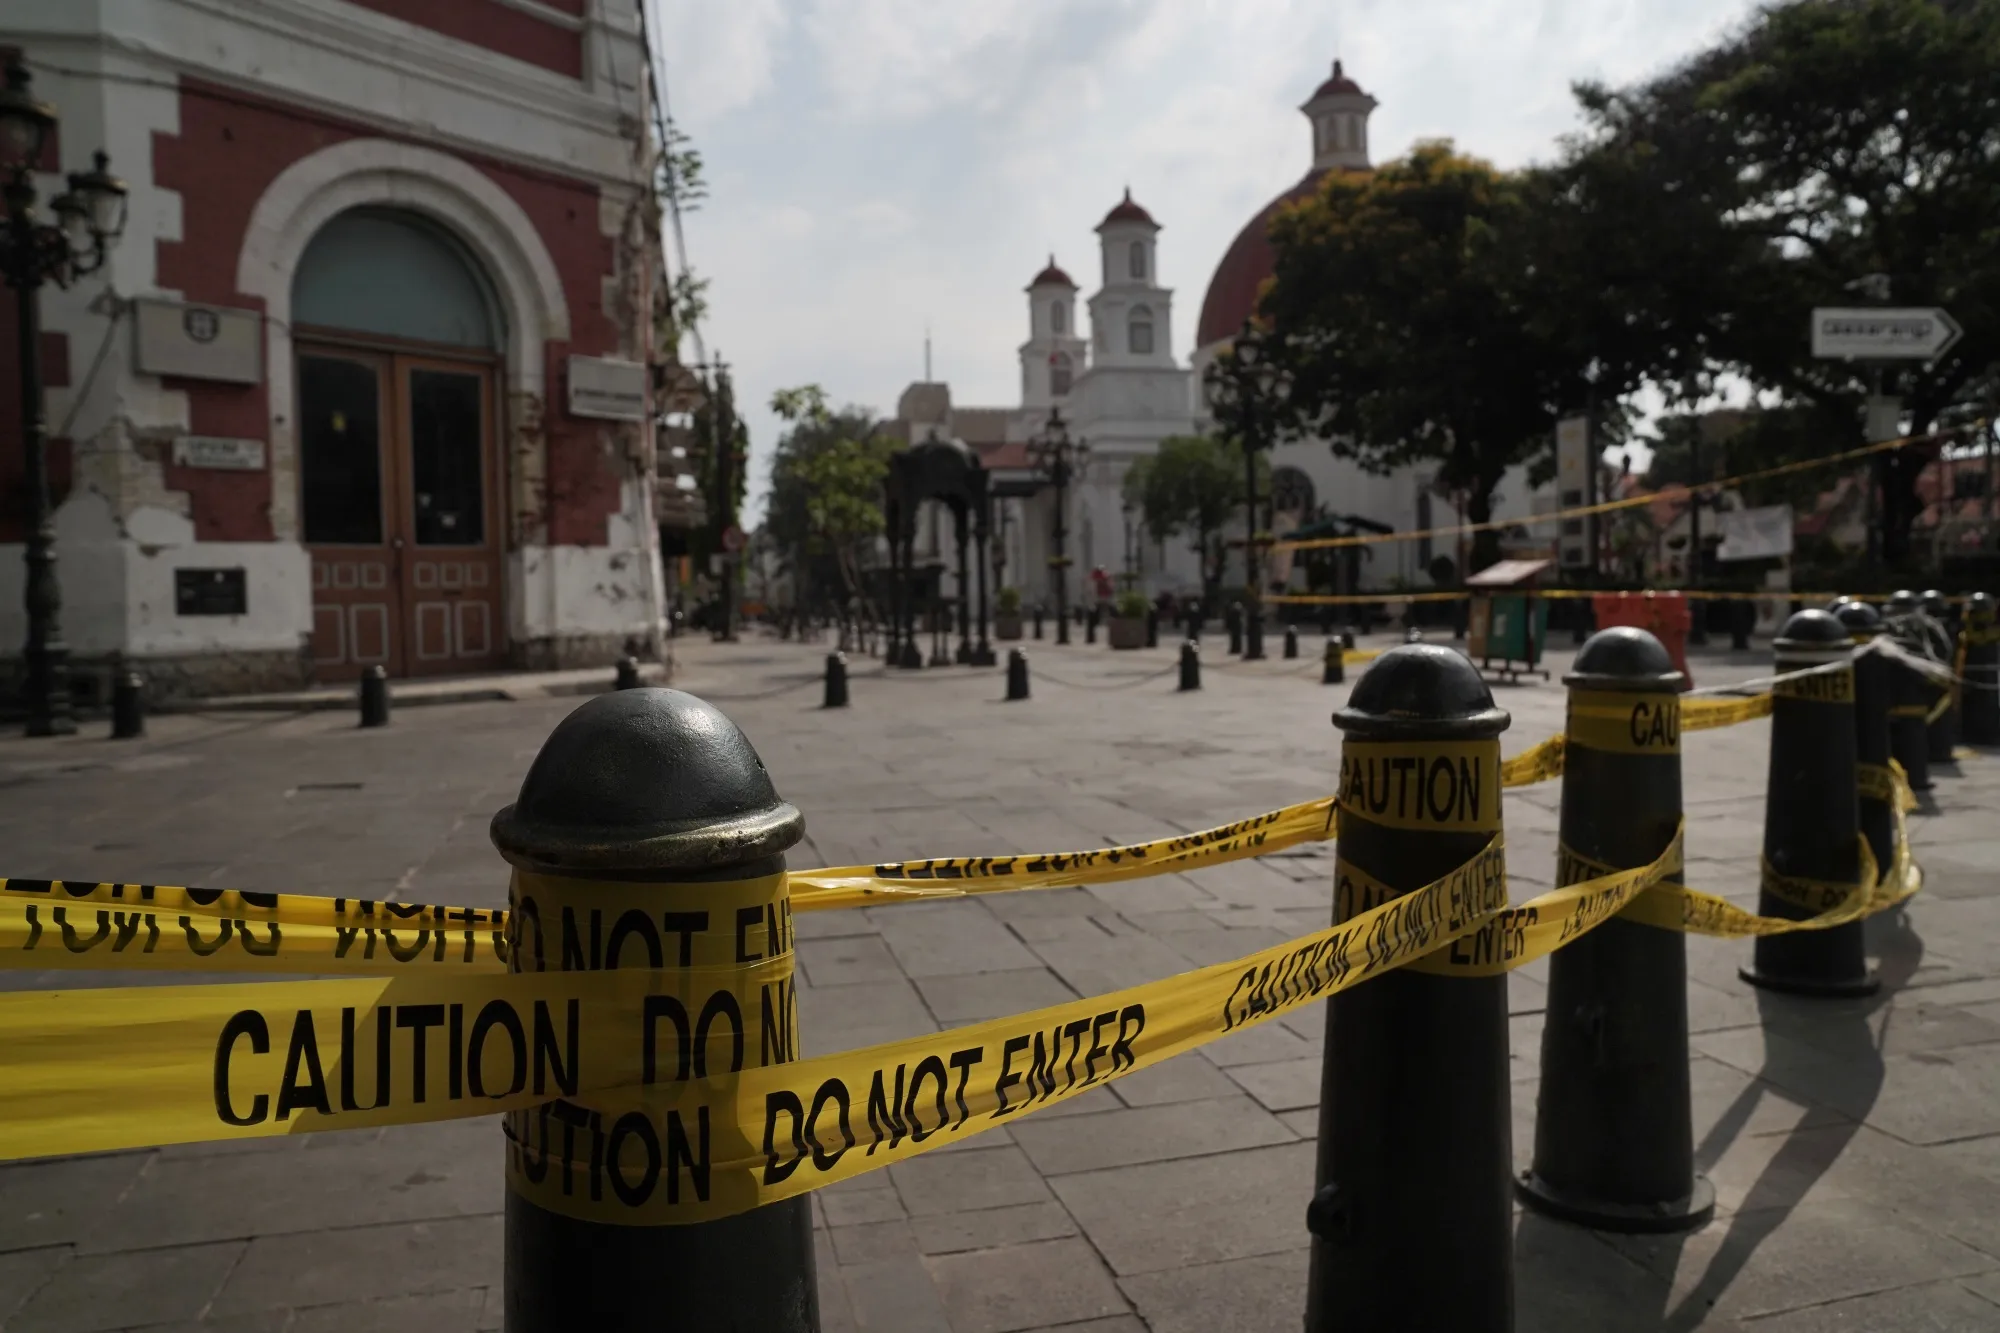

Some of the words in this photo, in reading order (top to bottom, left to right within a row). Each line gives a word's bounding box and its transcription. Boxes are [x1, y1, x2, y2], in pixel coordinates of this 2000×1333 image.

[562, 906, 709, 971] NOT
[214, 998, 580, 1127] CAUTION
[642, 989, 745, 1085] DO
[763, 1077, 856, 1186] DO
[866, 1046, 984, 1157] NOT
[989, 1003, 1146, 1119] ENTER
[1222, 926, 1363, 1033] CAUTION
[1364, 902, 1403, 973] DO
[1401, 880, 1446, 957] NOT
[1449, 848, 1503, 932] ENTER
